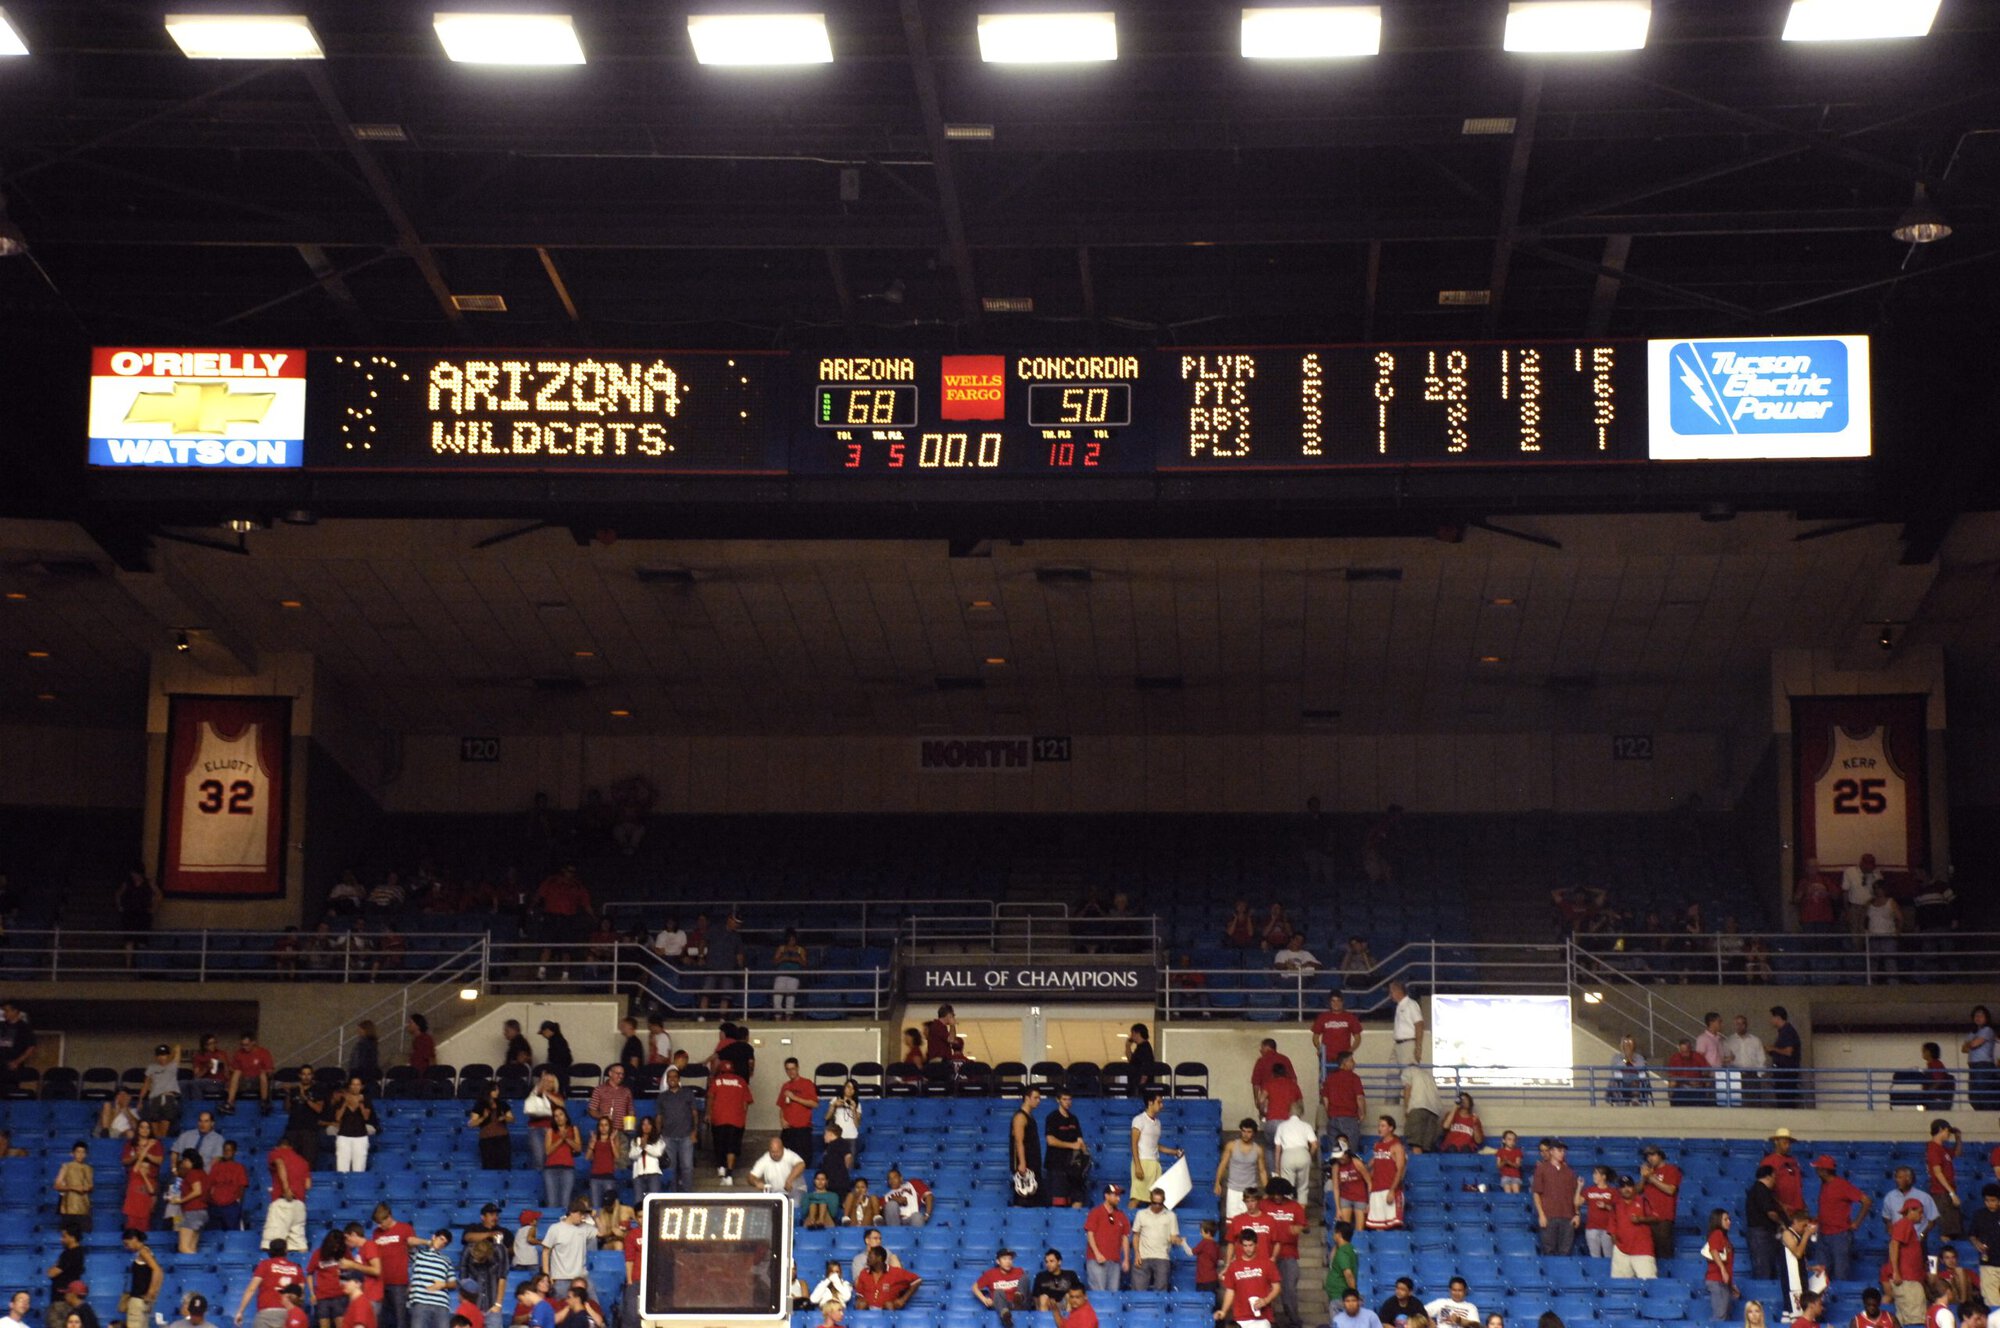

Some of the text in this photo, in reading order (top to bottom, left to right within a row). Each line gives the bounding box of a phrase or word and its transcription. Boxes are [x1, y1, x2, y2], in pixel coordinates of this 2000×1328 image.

[110, 352, 288, 377] O'RIELLY
[819, 357, 915, 381] ARIZONA
[1018, 356, 1139, 380] CONCORDIA
[1181, 354, 1255, 380] PLYR
[1428, 350, 1468, 375] 10
[1501, 348, 1541, 373] 12
[1574, 347, 1614, 371] 15
[1711, 351, 1812, 375] Tucson
[428, 359, 680, 416] ARIZONA
[944, 374, 1003, 387] WELLS
[1194, 381, 1246, 405] PTS
[1501, 374, 1541, 400] 13
[1722, 373, 1832, 398] Electric
[847, 390, 896, 424] 68
[946, 388, 1002, 401] FARGO
[1060, 388, 1109, 423] 50
[1731, 396, 1834, 421] Power
[432, 421, 668, 456] WILDCATS
[918, 432, 1002, 468] 00.0
[107, 440, 287, 465] WATSON
[844, 443, 862, 468] 3
[888, 443, 906, 468] 5
[1049, 443, 1075, 466] 10
[1083, 442, 1101, 467] 2
[463, 739, 499, 760] 120
[922, 740, 1028, 768] NORTH
[1036, 738, 1070, 760] 121
[203, 759, 254, 773] ELLIOTT
[1842, 757, 1877, 770] KERR
[198, 779, 255, 815] 32
[1832, 778, 1887, 815] 25
[925, 970, 1139, 988] HALL OF CHAMPIONS
[659, 1207, 746, 1241] 00.0
